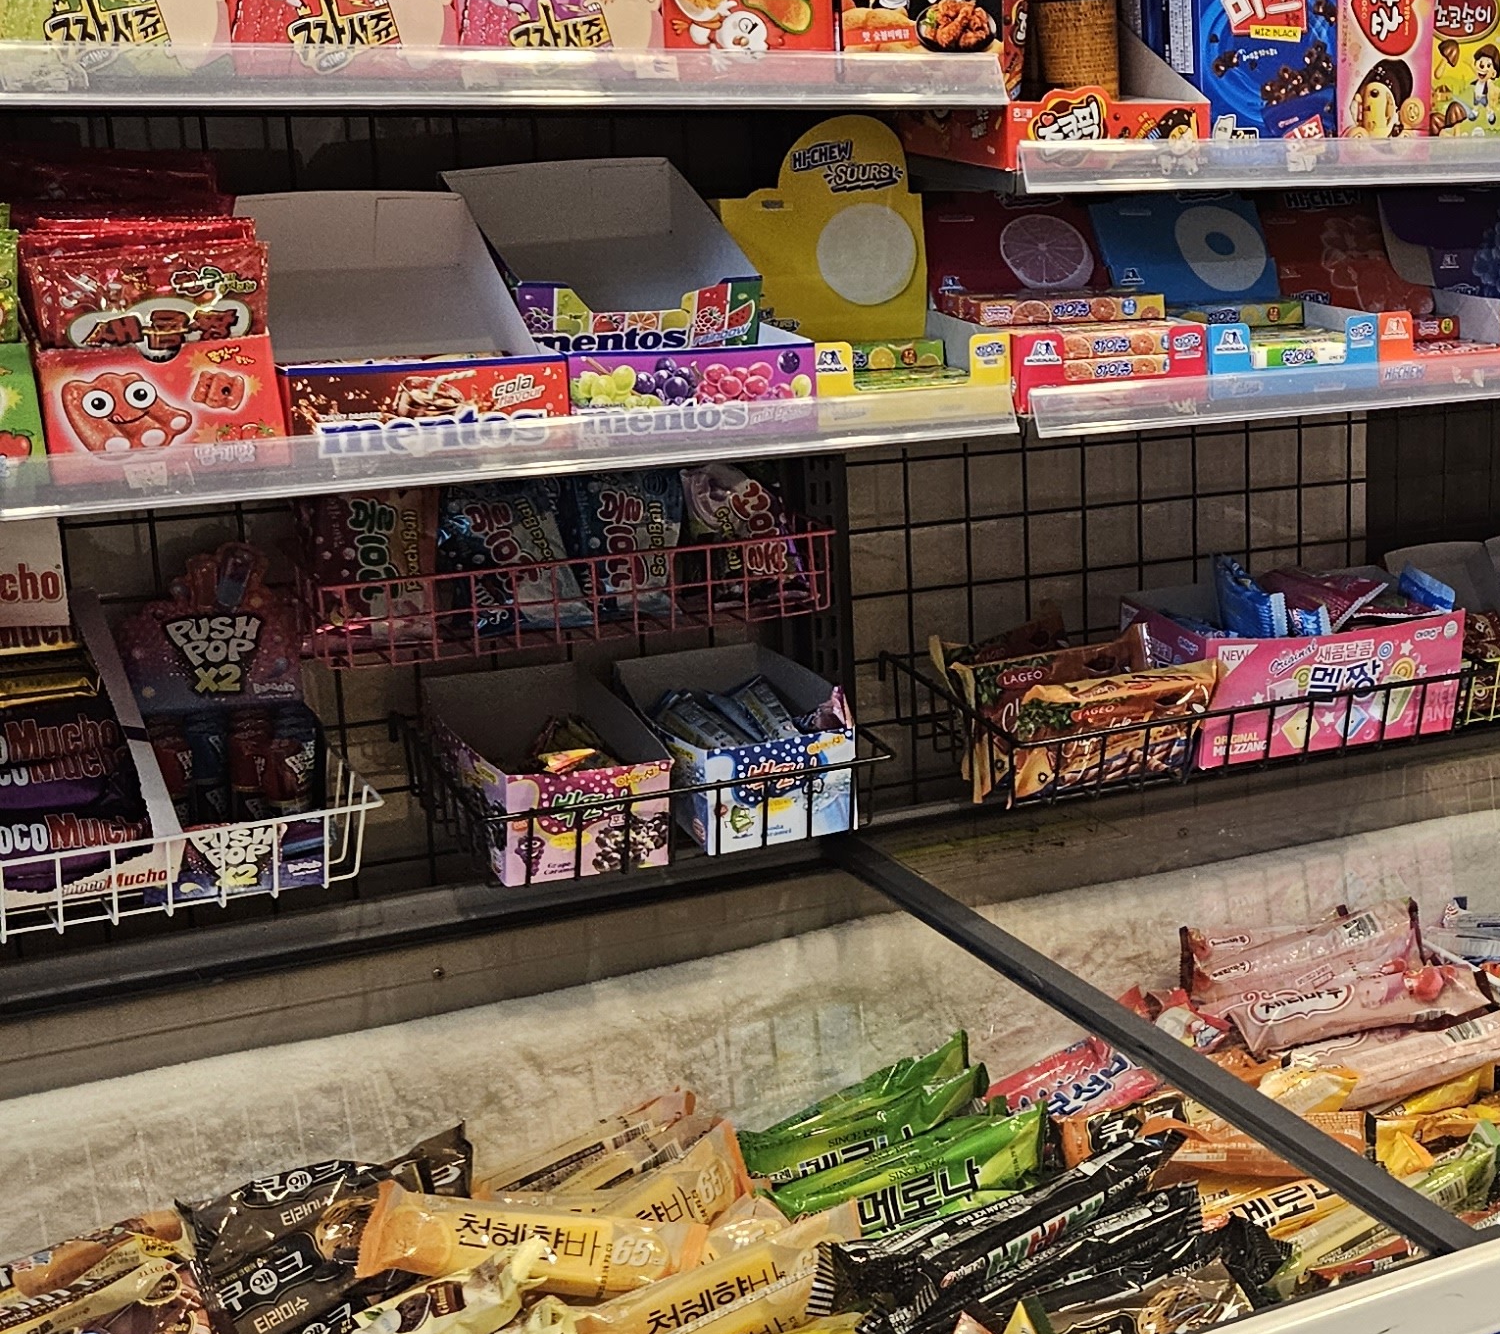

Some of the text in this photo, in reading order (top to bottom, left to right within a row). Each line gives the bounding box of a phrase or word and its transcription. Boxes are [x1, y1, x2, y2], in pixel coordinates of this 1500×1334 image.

[1273, 28, 1298, 41] BLACK
[791, 139, 854, 171] HI-CHEW
[835, 163, 893, 186] SOURS
[532, 324, 750, 351] mentos rainbow
[492, 375, 535, 400] cola
[498, 386, 545, 409] flavour
[166, 616, 262, 643] PUSH
[182, 637, 256, 665] POP
[1220, 648, 1251, 663] NEW
[1269, 641, 1318, 675] Original
[1316, 641, 1375, 663] 새콤달콤
[1003, 668, 1043, 685] LAGEO
[1077, 703, 1115, 719] LAGEO
[190, 824, 273, 848] PUSH
[204, 844, 270, 868] POP
[1107, 1163, 1152, 1196] SINCE 1975
[857, 1157, 983, 1235] 메로나
[612, 1234, 651, 1265] 65
[253, 1295, 310, 1334] 티라미수
